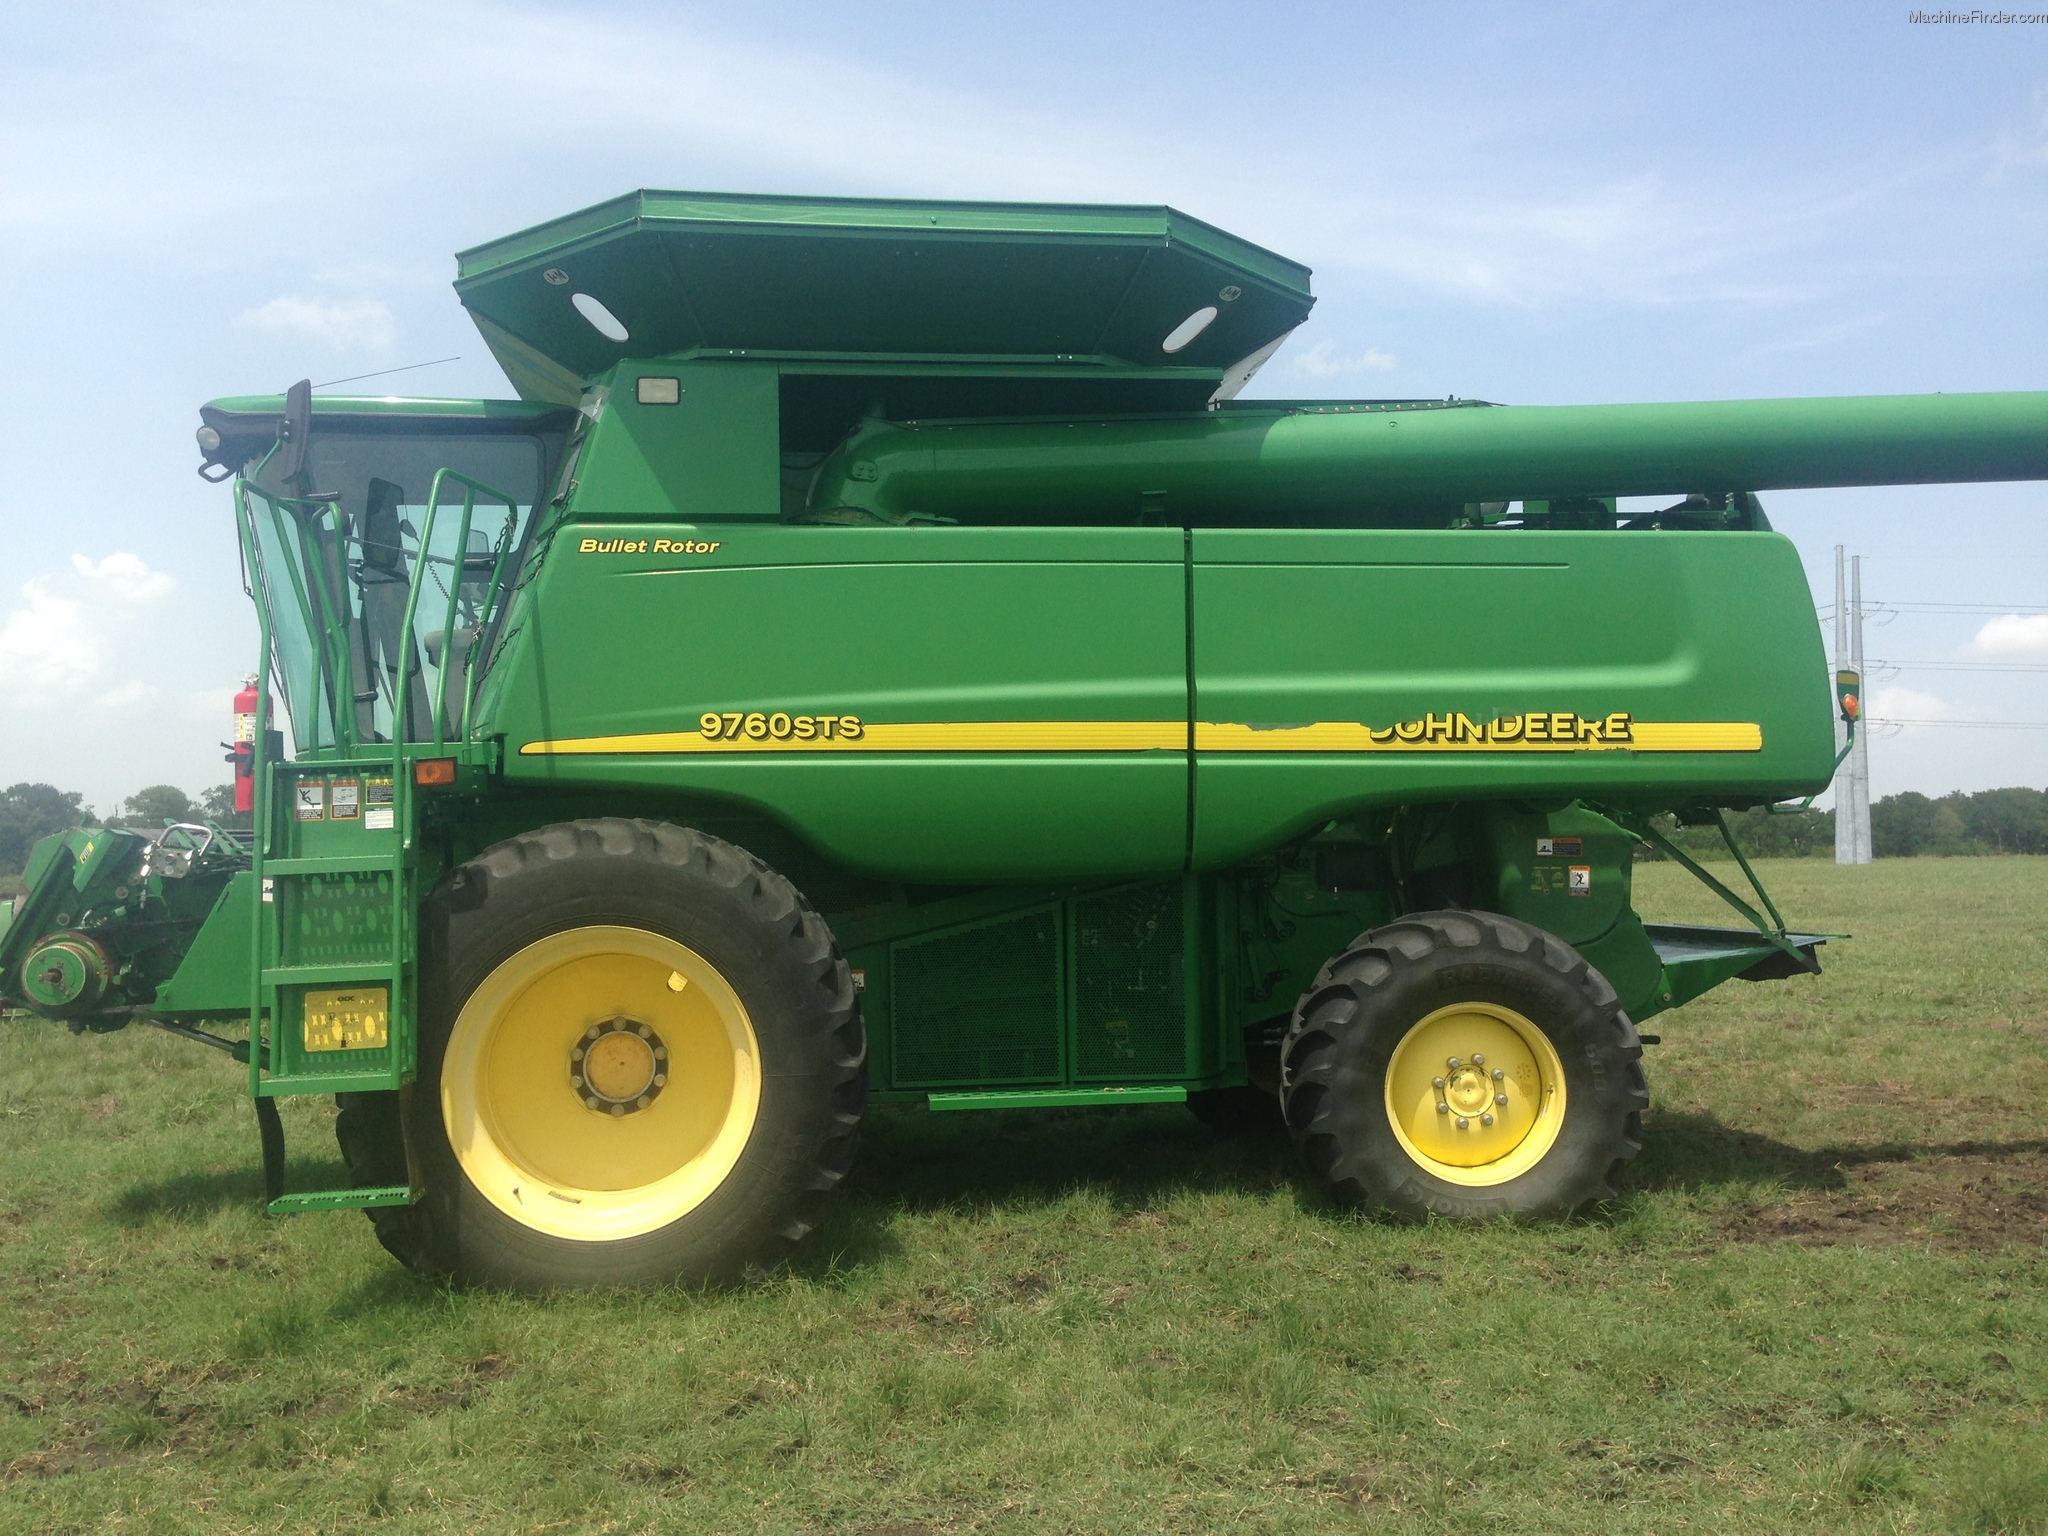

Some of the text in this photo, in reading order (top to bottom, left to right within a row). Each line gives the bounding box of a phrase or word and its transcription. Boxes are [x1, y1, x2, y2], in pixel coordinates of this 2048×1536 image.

[578, 538, 720, 554] Bullet Rotor
[699, 711, 865, 741] 9760STS
[1491, 711, 1633, 742] DEERE
